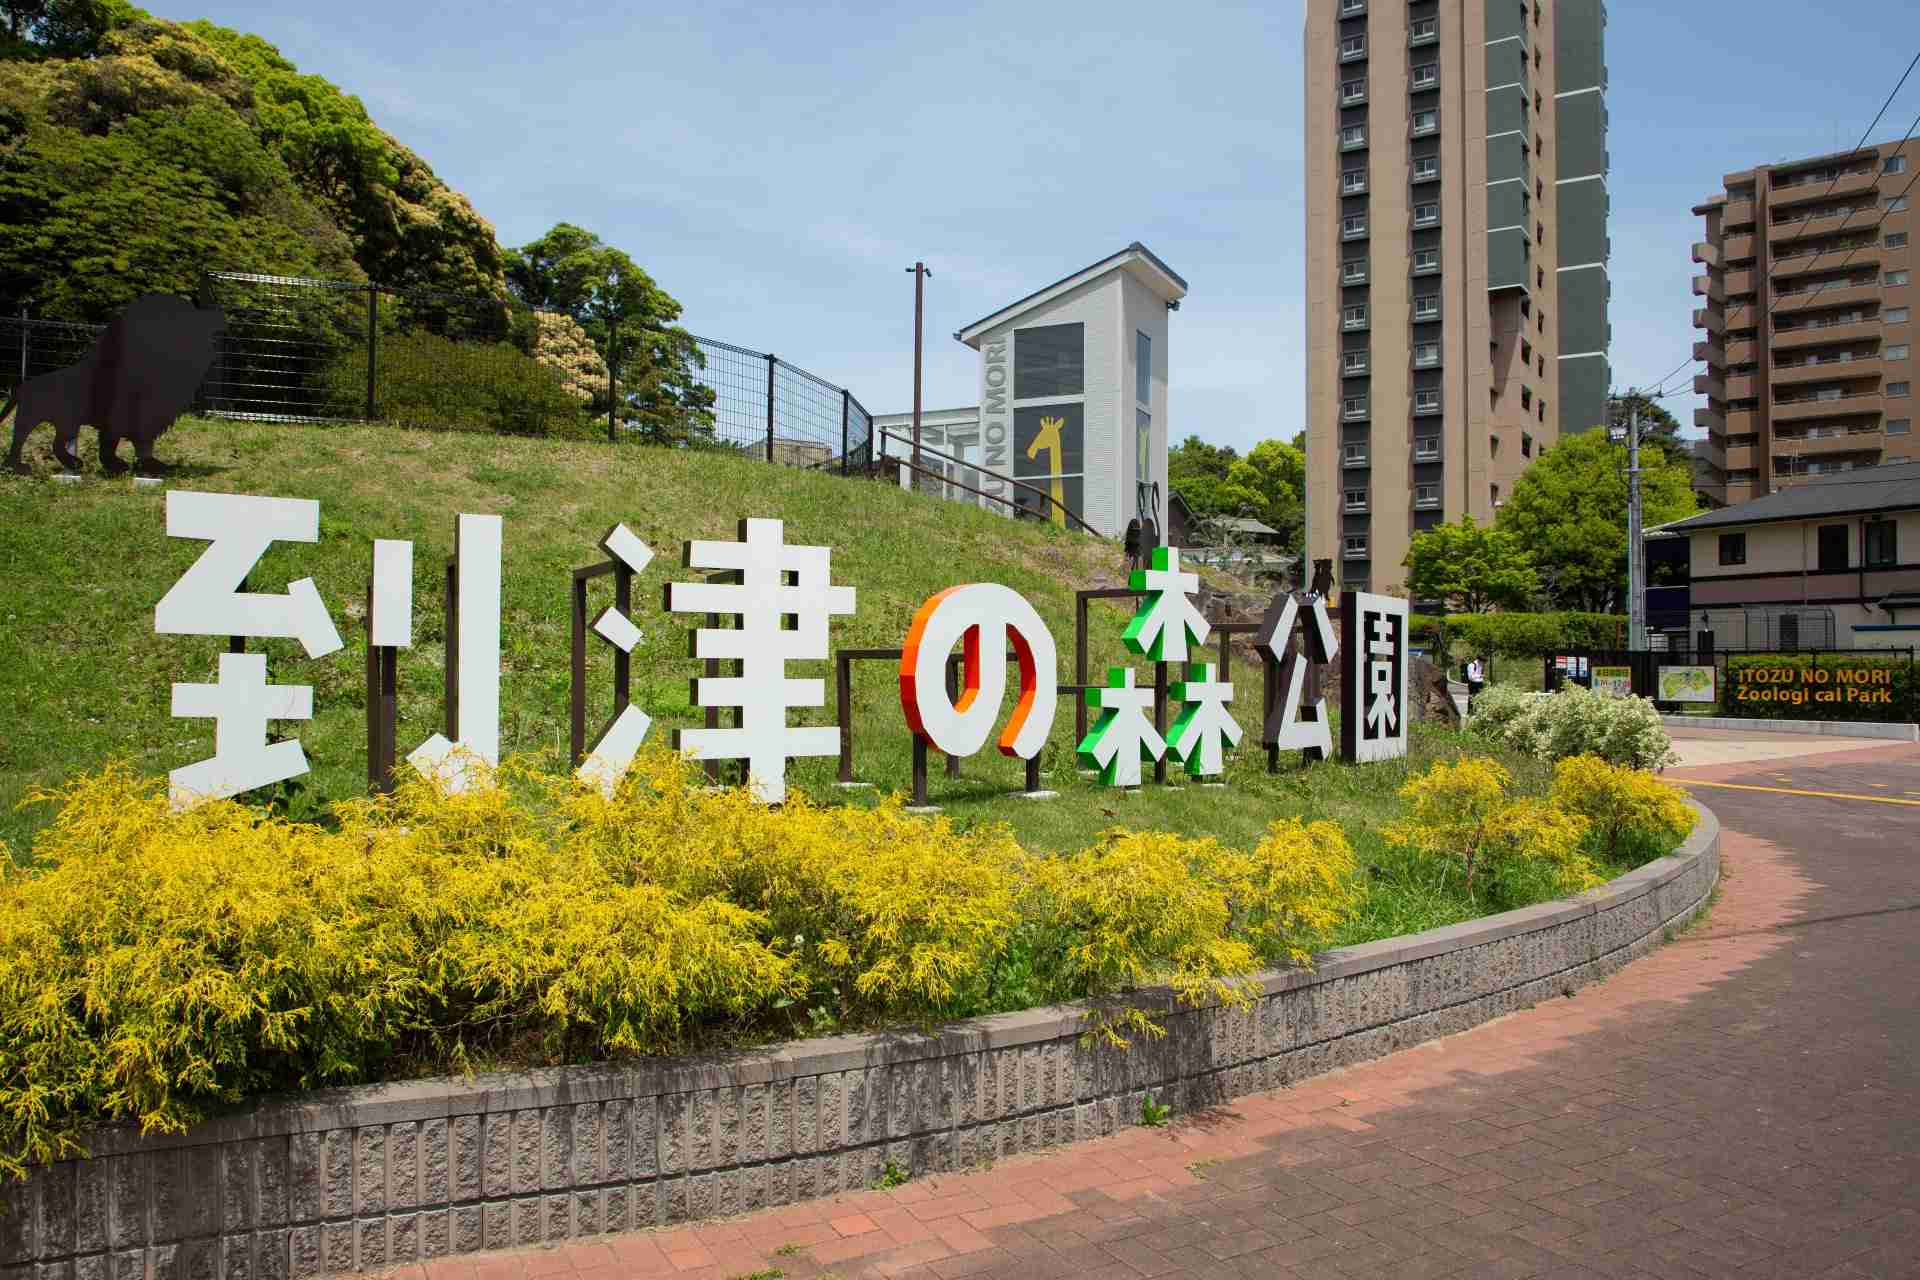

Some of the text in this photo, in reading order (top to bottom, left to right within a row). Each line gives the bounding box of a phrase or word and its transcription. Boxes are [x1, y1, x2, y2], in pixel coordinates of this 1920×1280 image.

[984, 335, 1006, 415] MORI
[984, 422, 1006, 466] NO
[1738, 668, 1890, 684] ITOZU NO MORI
[1847, 687, 1892, 703] Park
